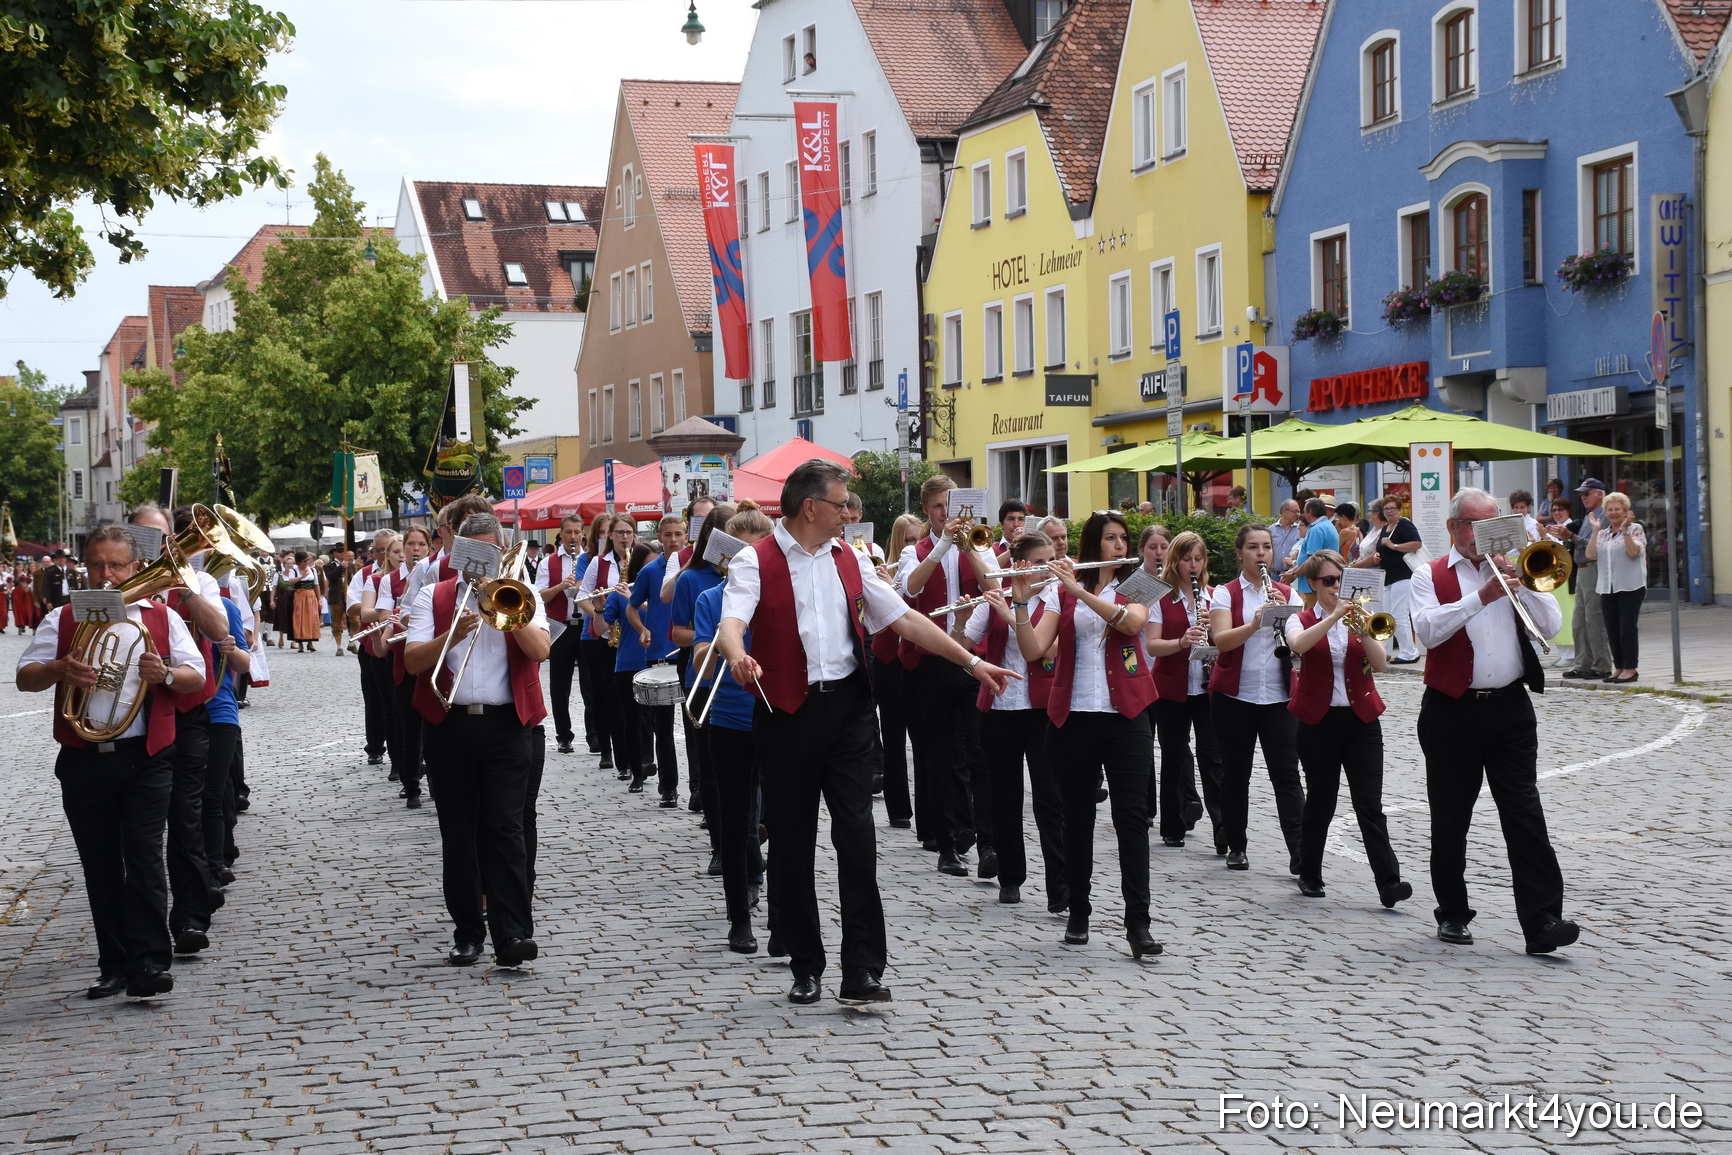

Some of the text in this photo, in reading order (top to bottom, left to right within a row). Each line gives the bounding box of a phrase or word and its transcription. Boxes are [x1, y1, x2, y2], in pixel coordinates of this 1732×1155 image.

[802, 111, 823, 172] K&L
[822, 111, 832, 172] RUPPERT
[1659, 196, 1686, 220] CAFÉ
[992, 244, 1083, 290] HOTEL Lehmeier
[1167, 318, 1177, 354] P
[1240, 350, 1250, 388] P
[1048, 394, 1090, 402] TAIFUN
[1136, 374, 1168, 396] TAIFU
[1306, 361, 1429, 412] APOTHEKE
[991, 410, 1044, 436] Restaurant
[605, 463, 612, 487] P
[506, 489, 524, 497] TAXI
